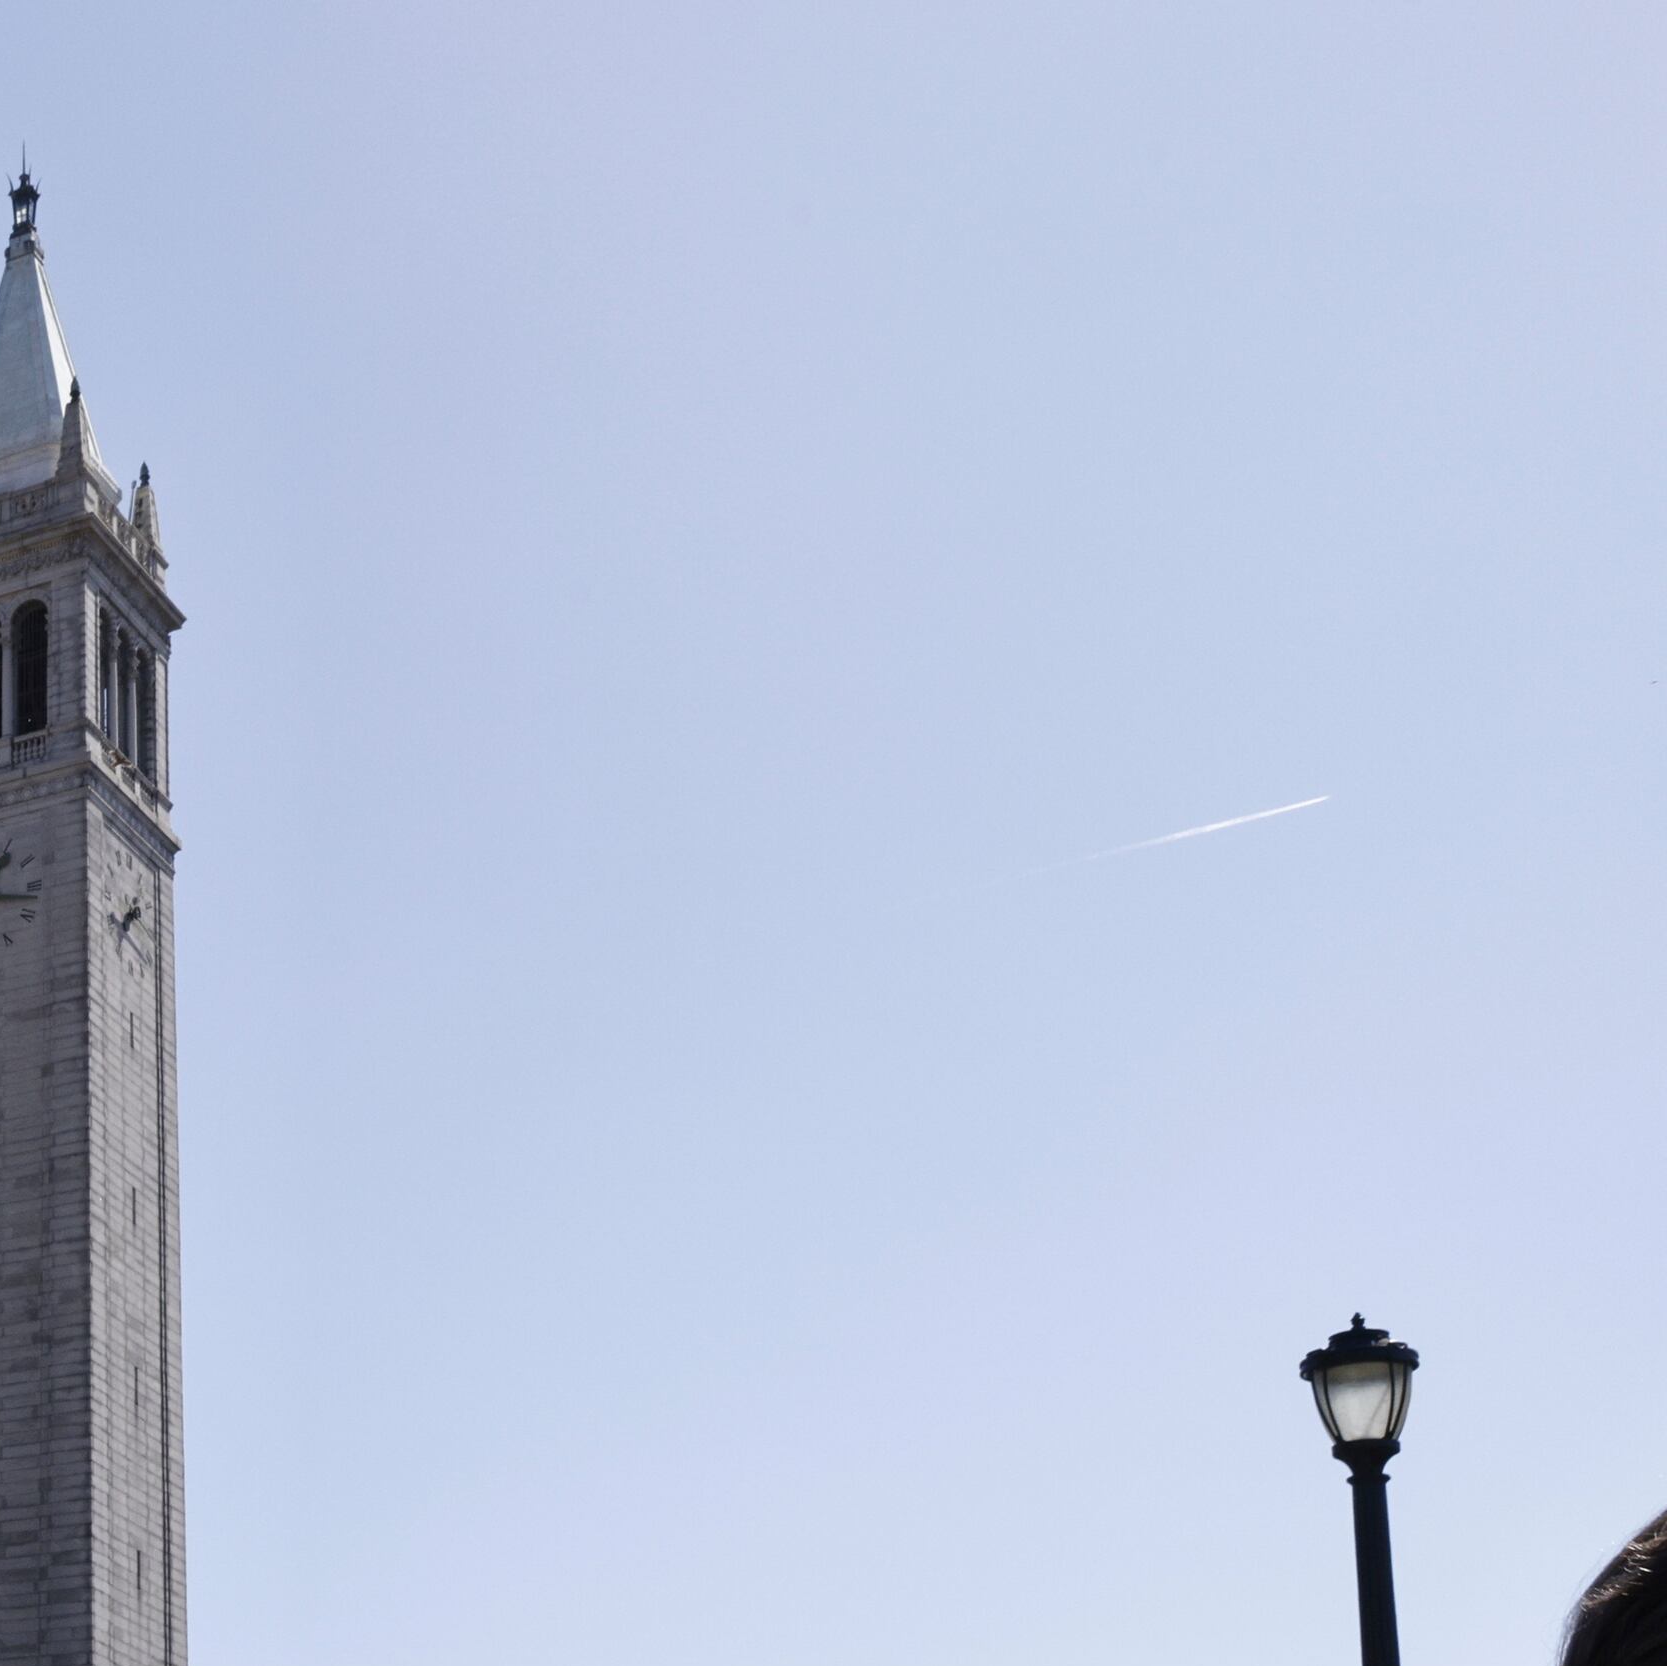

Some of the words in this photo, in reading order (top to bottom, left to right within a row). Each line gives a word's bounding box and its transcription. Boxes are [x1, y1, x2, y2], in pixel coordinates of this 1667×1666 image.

[20, 854, 36, 869] II
[26, 879, 42, 892] III
[2, 933, 13, 947] V
